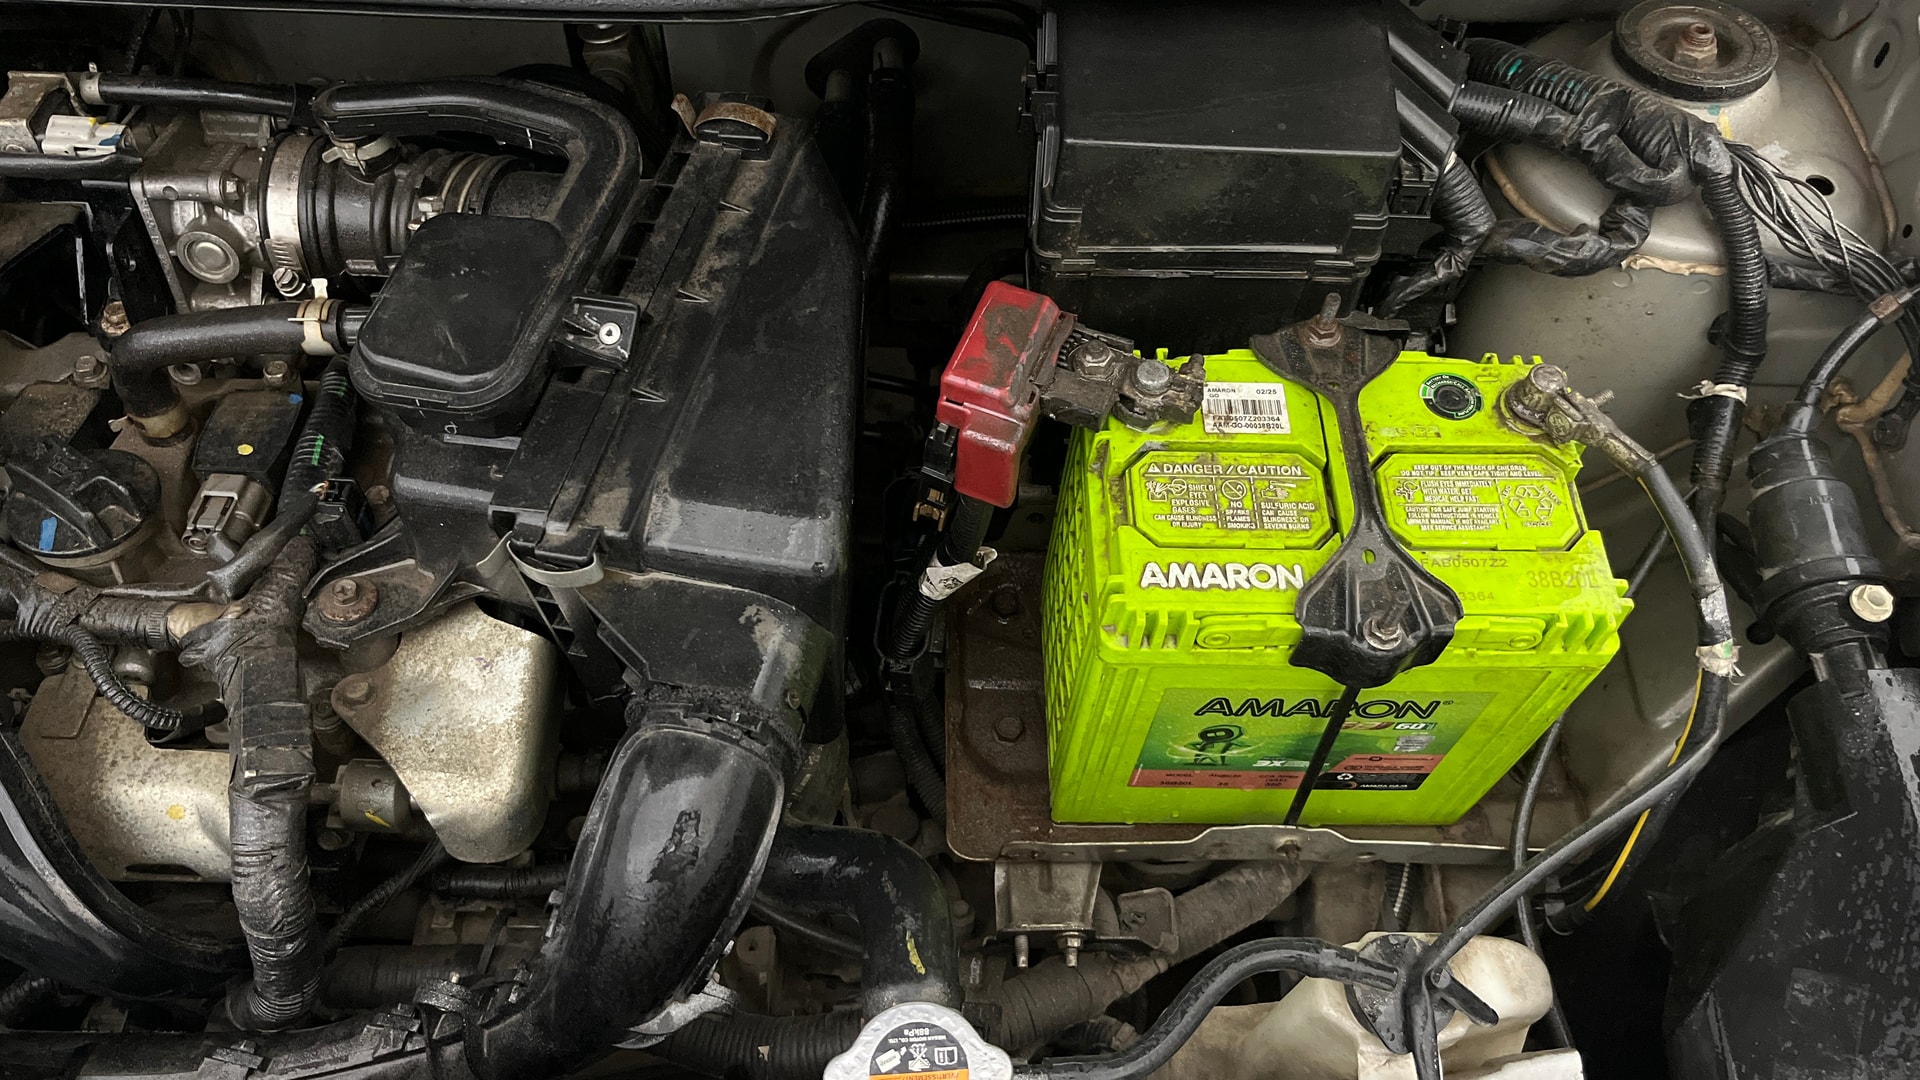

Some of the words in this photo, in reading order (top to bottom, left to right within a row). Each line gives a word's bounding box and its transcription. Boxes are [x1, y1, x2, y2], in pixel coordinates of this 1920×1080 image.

[1163, 464, 1223, 474] DANGER
[1226, 464, 1234, 474] /
[1236, 465, 1302, 476] CAUTION
[1171, 498, 1210, 507] EXPLOSIVE
[1261, 501, 1297, 510] SULFURIC
[1298, 502, 1315, 510] ACID
[1140, 562, 1304, 590] AMARON
[1526, 570, 1601, 588] 38B20L
[904, 1027, 930, 1036] 88kPa
